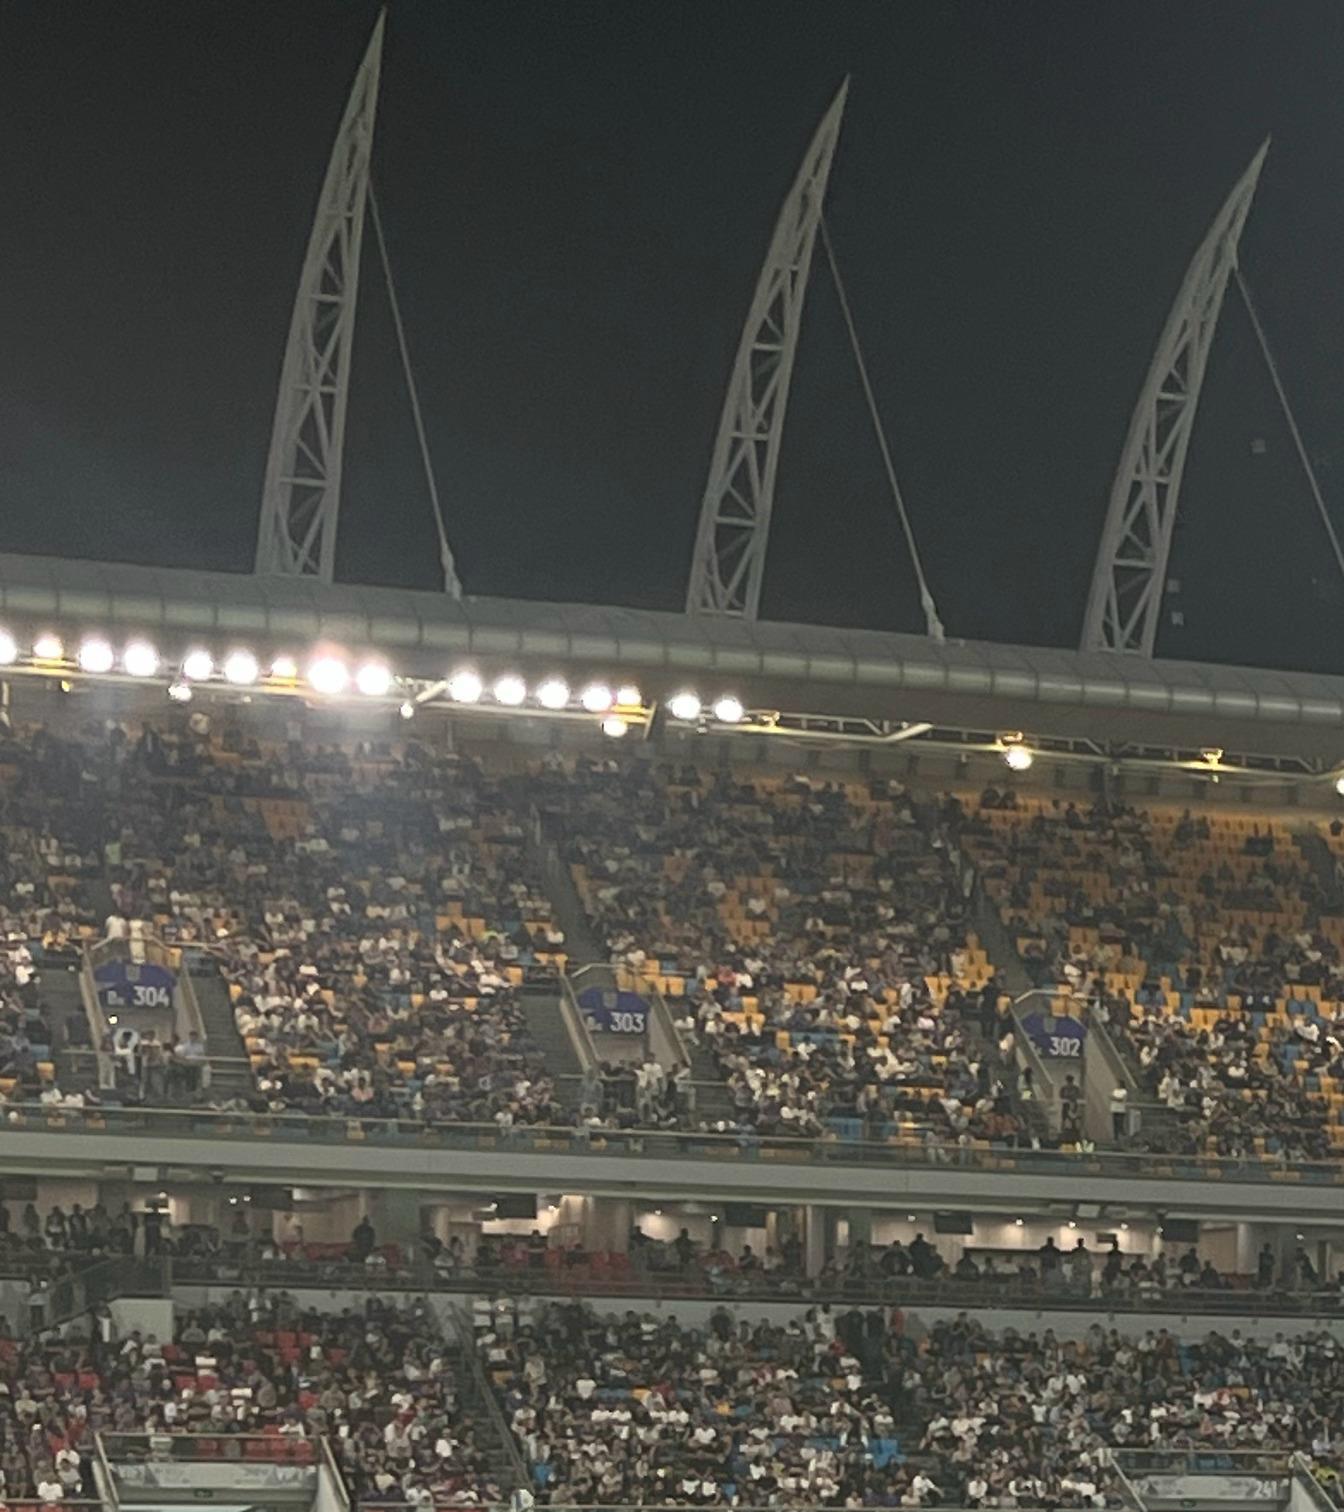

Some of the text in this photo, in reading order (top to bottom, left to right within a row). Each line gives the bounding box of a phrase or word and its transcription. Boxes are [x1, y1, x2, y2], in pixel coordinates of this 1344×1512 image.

[132, 985, 170, 1008] 304
[610, 1011, 646, 1033] 303
[1049, 1036, 1082, 1057] 302
